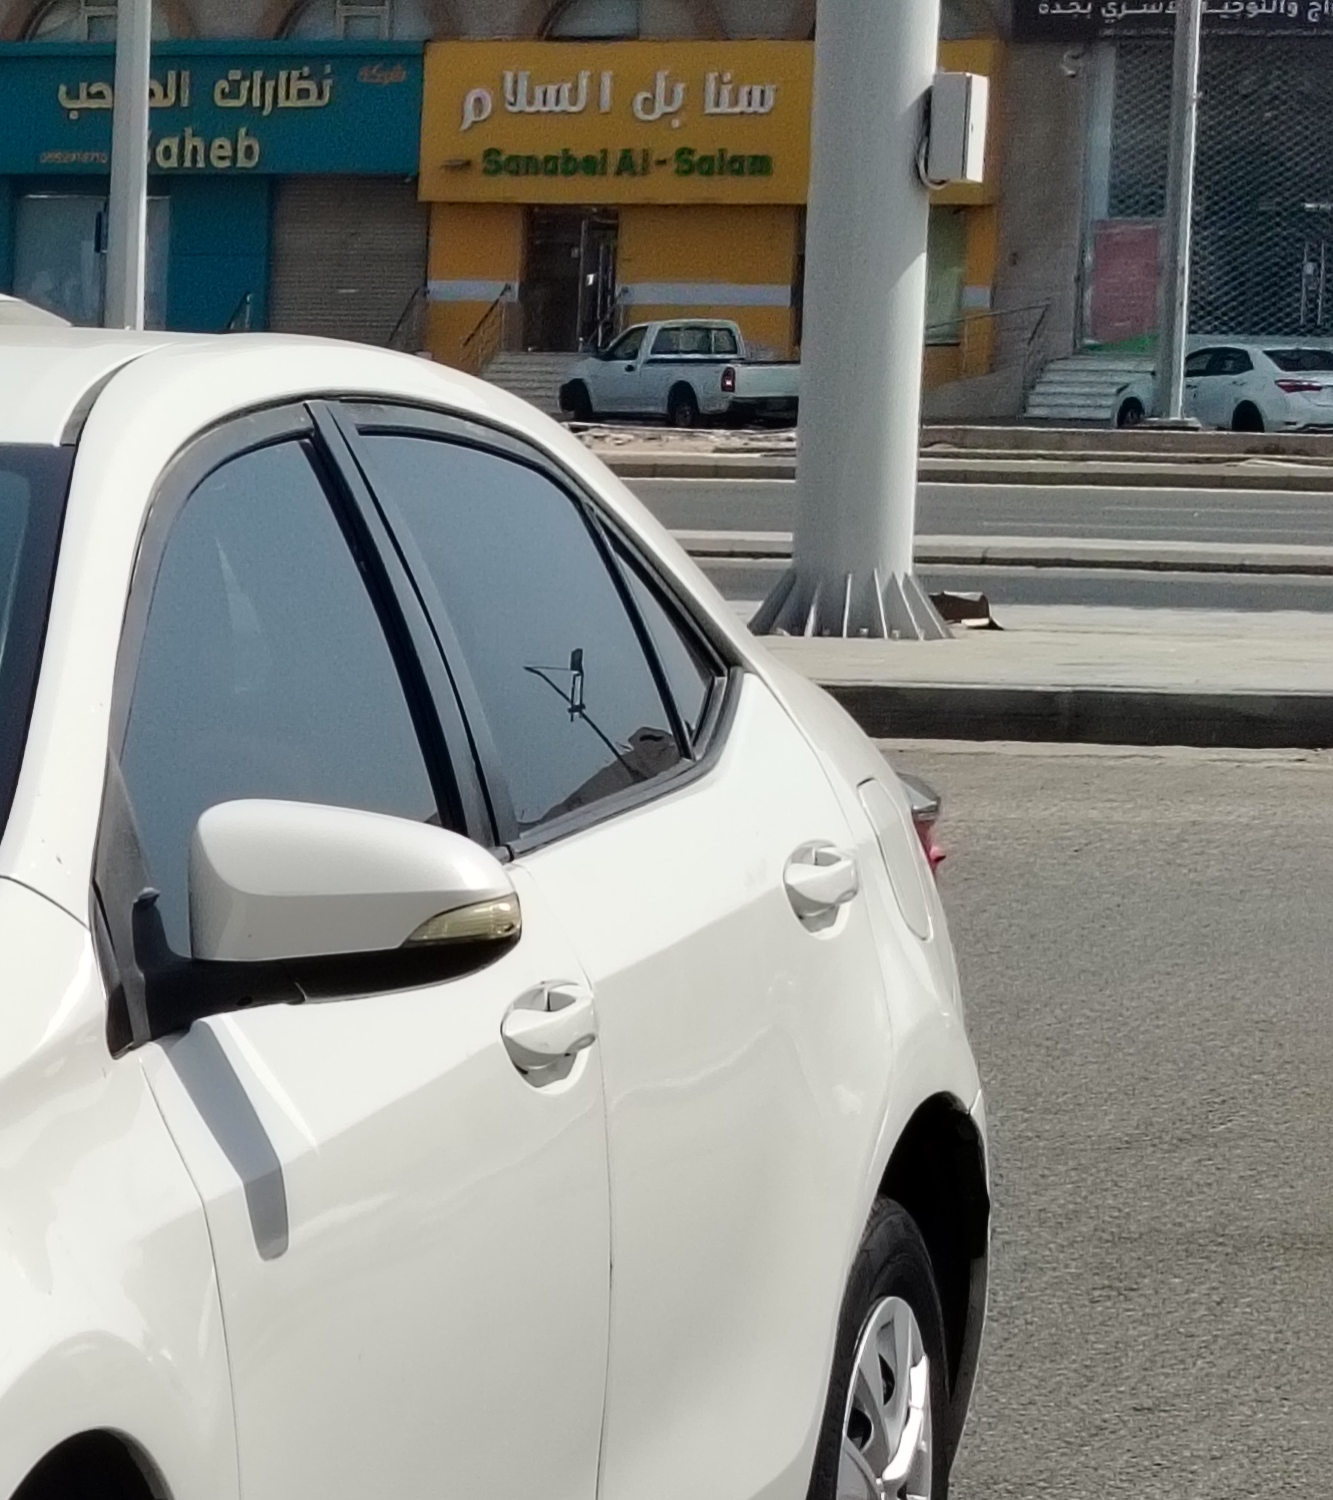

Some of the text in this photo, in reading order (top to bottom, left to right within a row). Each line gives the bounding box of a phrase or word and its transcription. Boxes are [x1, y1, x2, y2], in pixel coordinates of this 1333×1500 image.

[213, 64, 333, 117] نظارات
[459, 69, 614, 131] السلام
[146, 126, 261, 169] aheb
